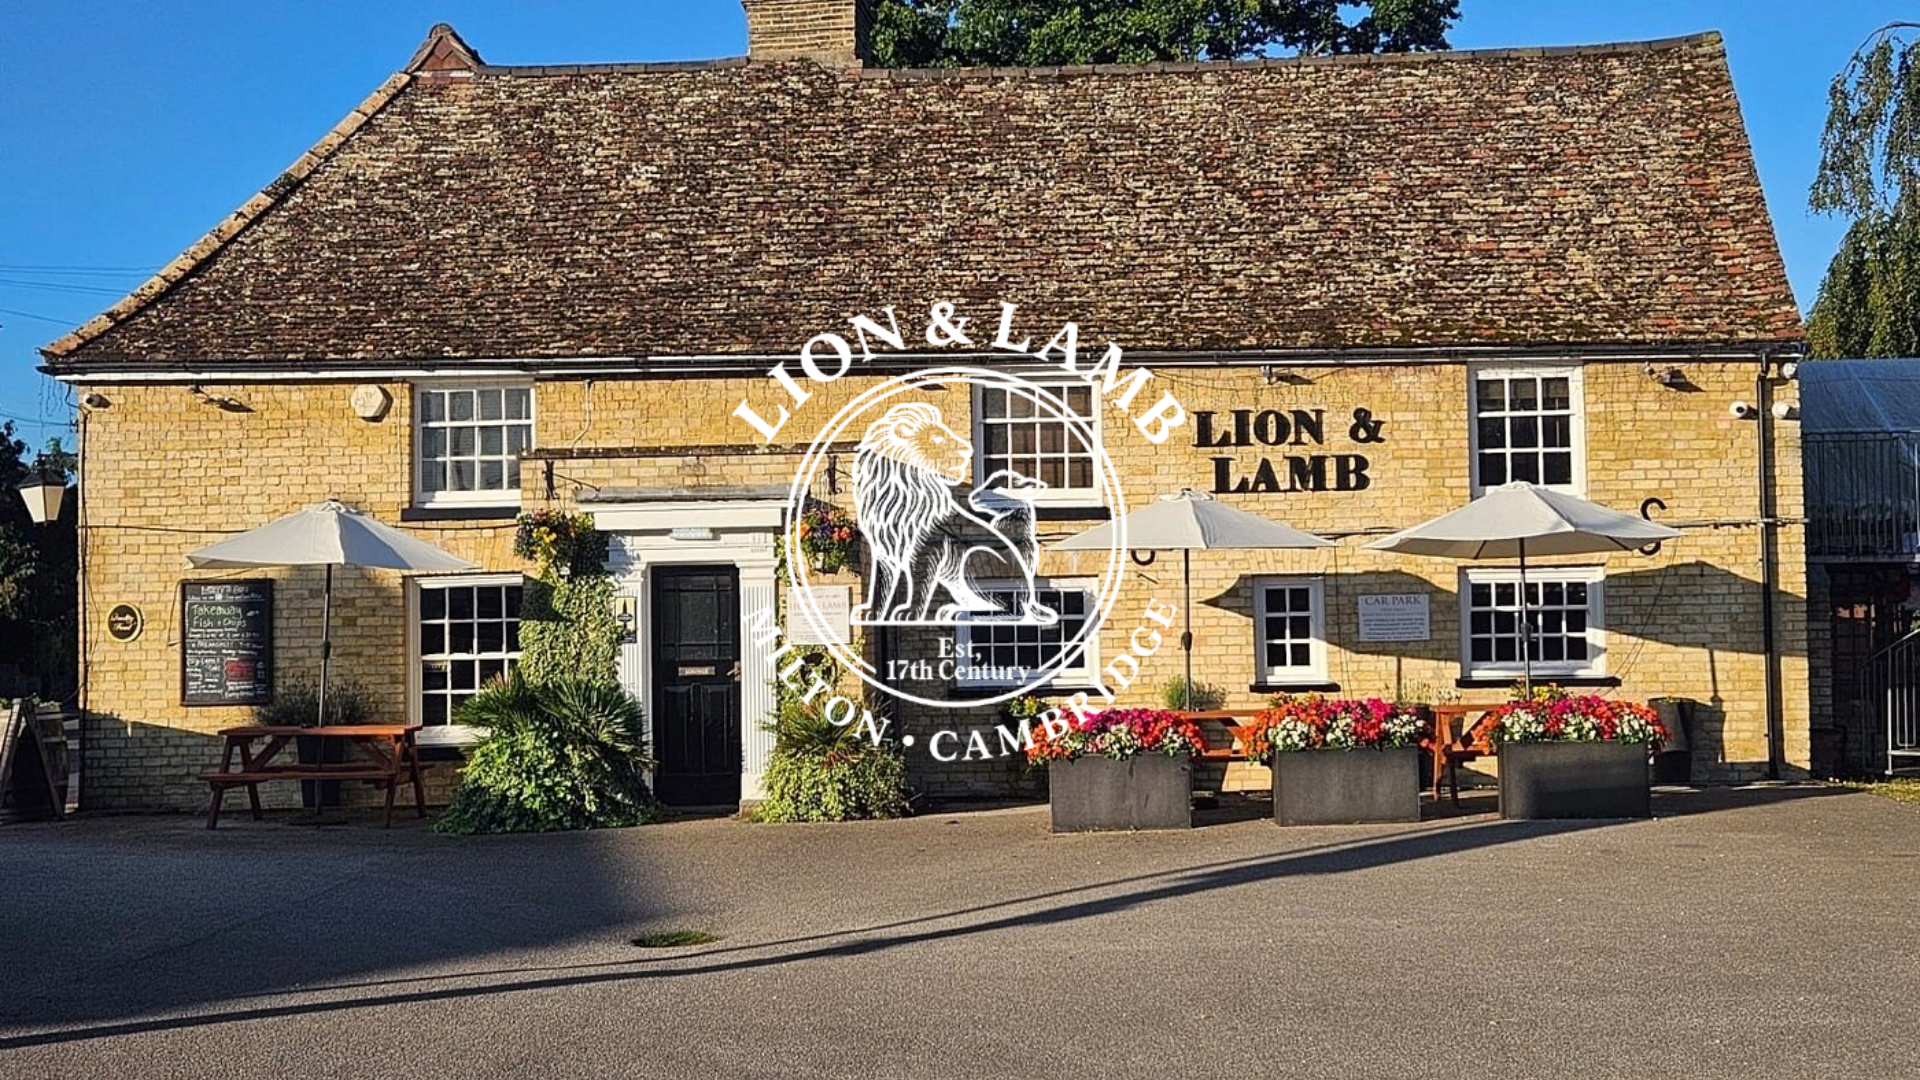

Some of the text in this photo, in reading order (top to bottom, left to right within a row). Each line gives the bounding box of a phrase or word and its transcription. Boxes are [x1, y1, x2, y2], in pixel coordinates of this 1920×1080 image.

[1192, 407, 1385, 448] LION &
[1210, 454, 1370, 495] LAMB
[1364, 594, 1421, 607] CAR PARK
[191, 604, 244, 620] Takeaway
[192, 615, 214, 628] Fish
